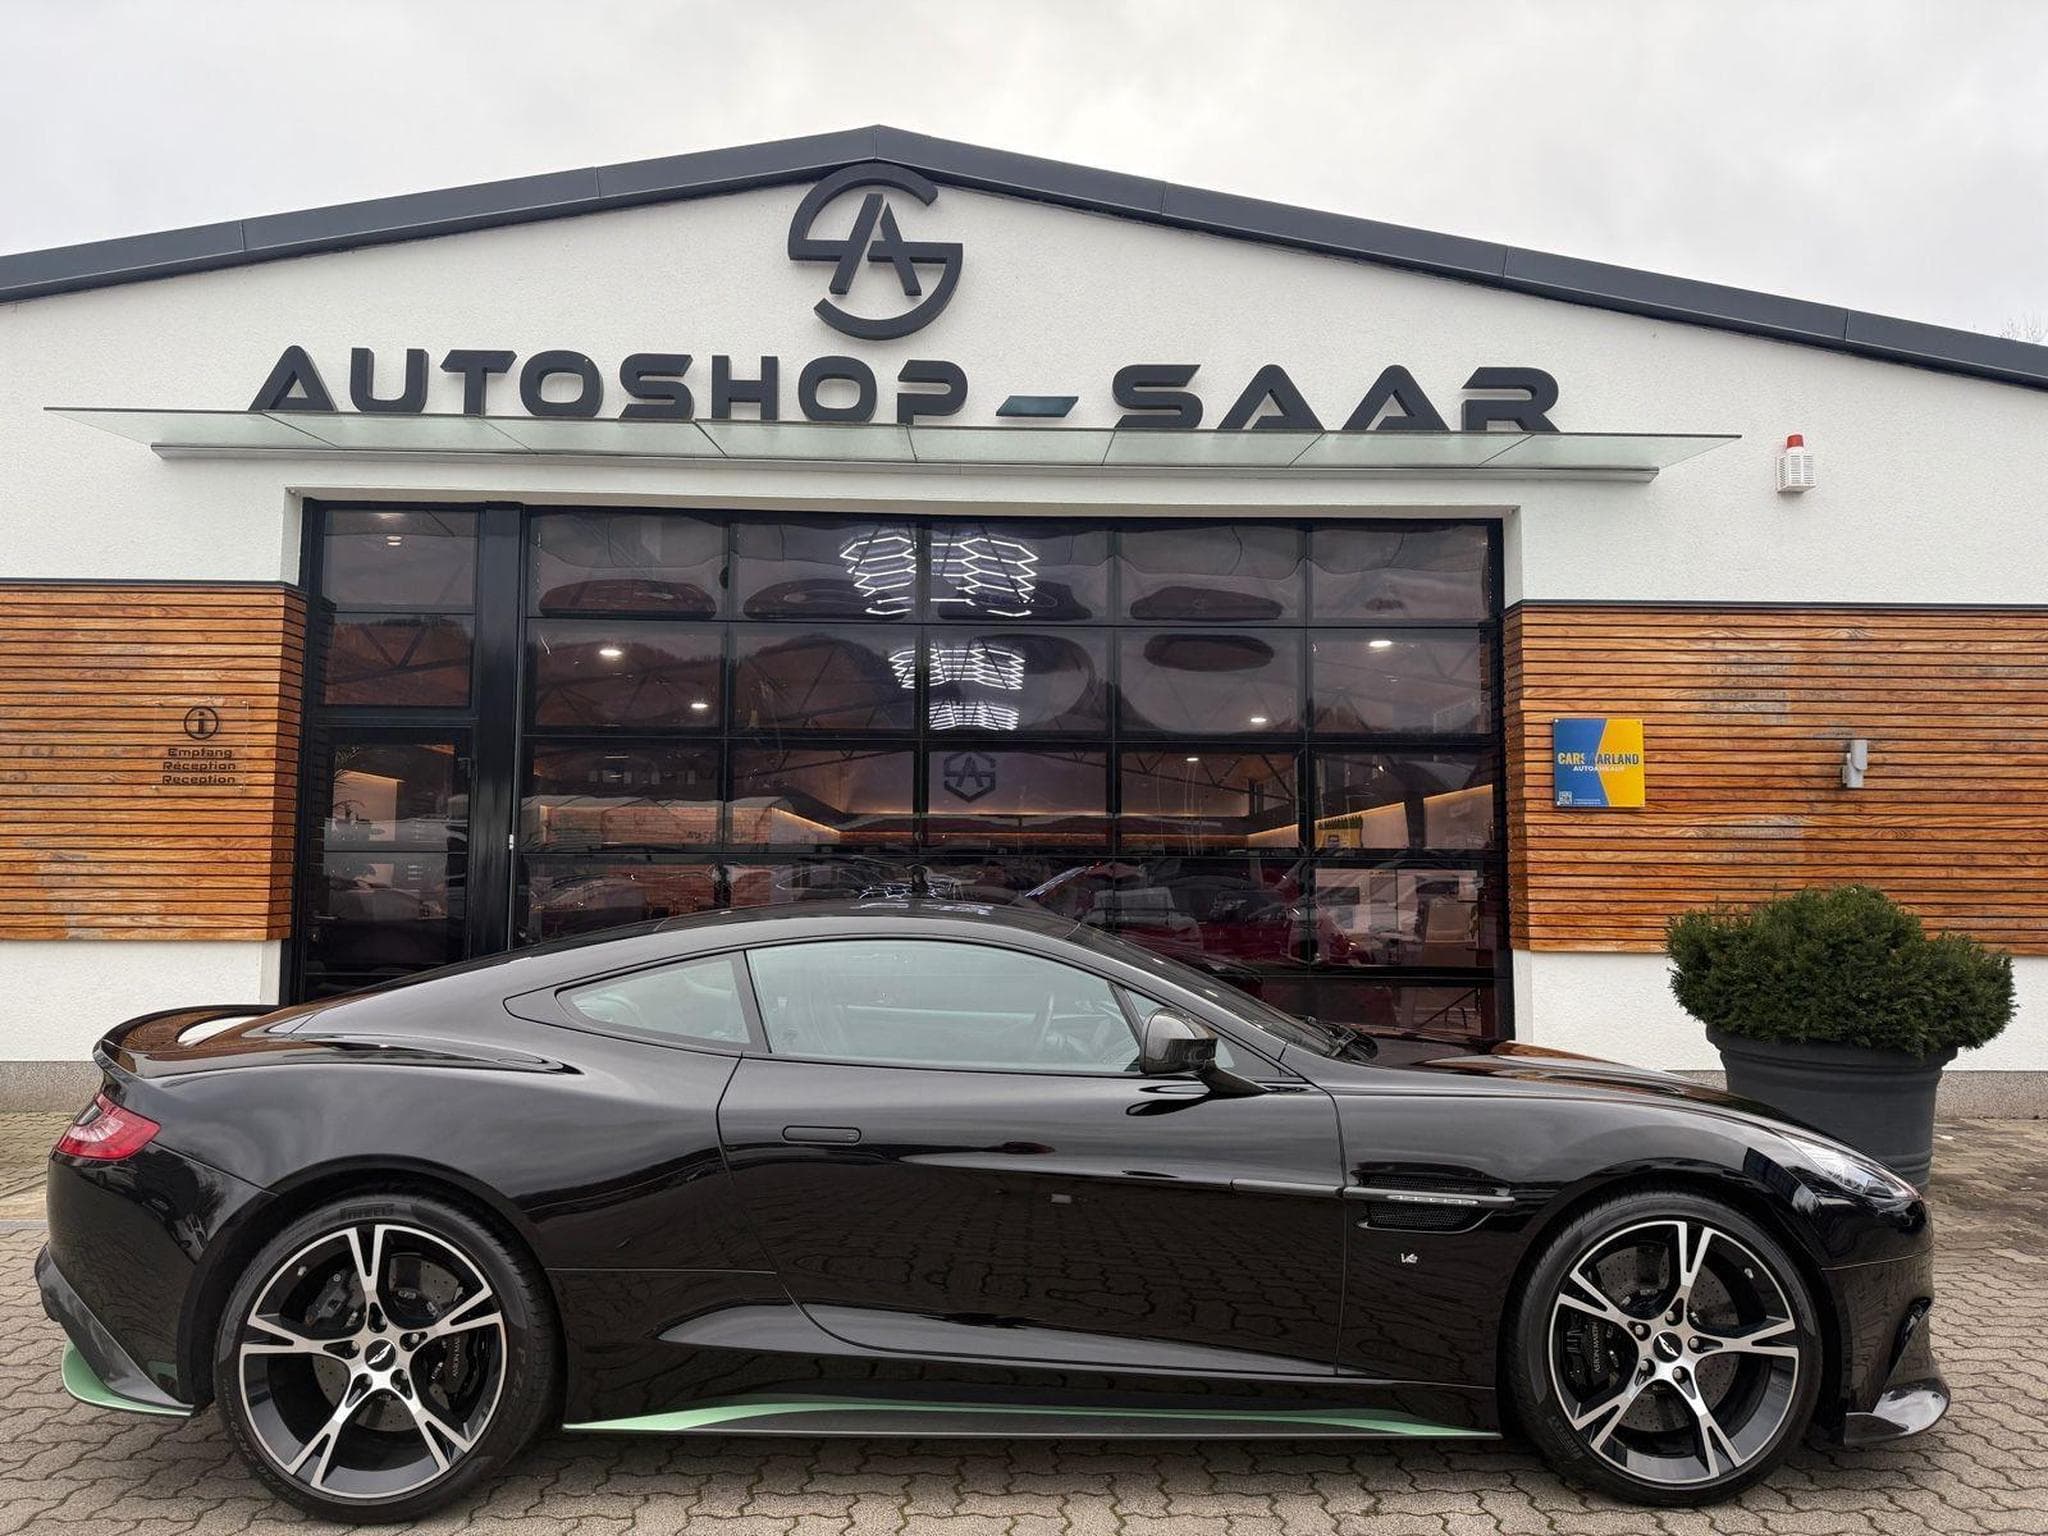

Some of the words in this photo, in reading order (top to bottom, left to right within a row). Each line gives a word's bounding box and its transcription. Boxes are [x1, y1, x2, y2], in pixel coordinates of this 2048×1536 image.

[248, 344, 968, 425] AUTOSHOP
[1112, 362, 1560, 432] SAAR
[167, 748, 233, 759] Empfang
[162, 760, 236, 771] Réception
[161, 774, 236, 785] Reception
